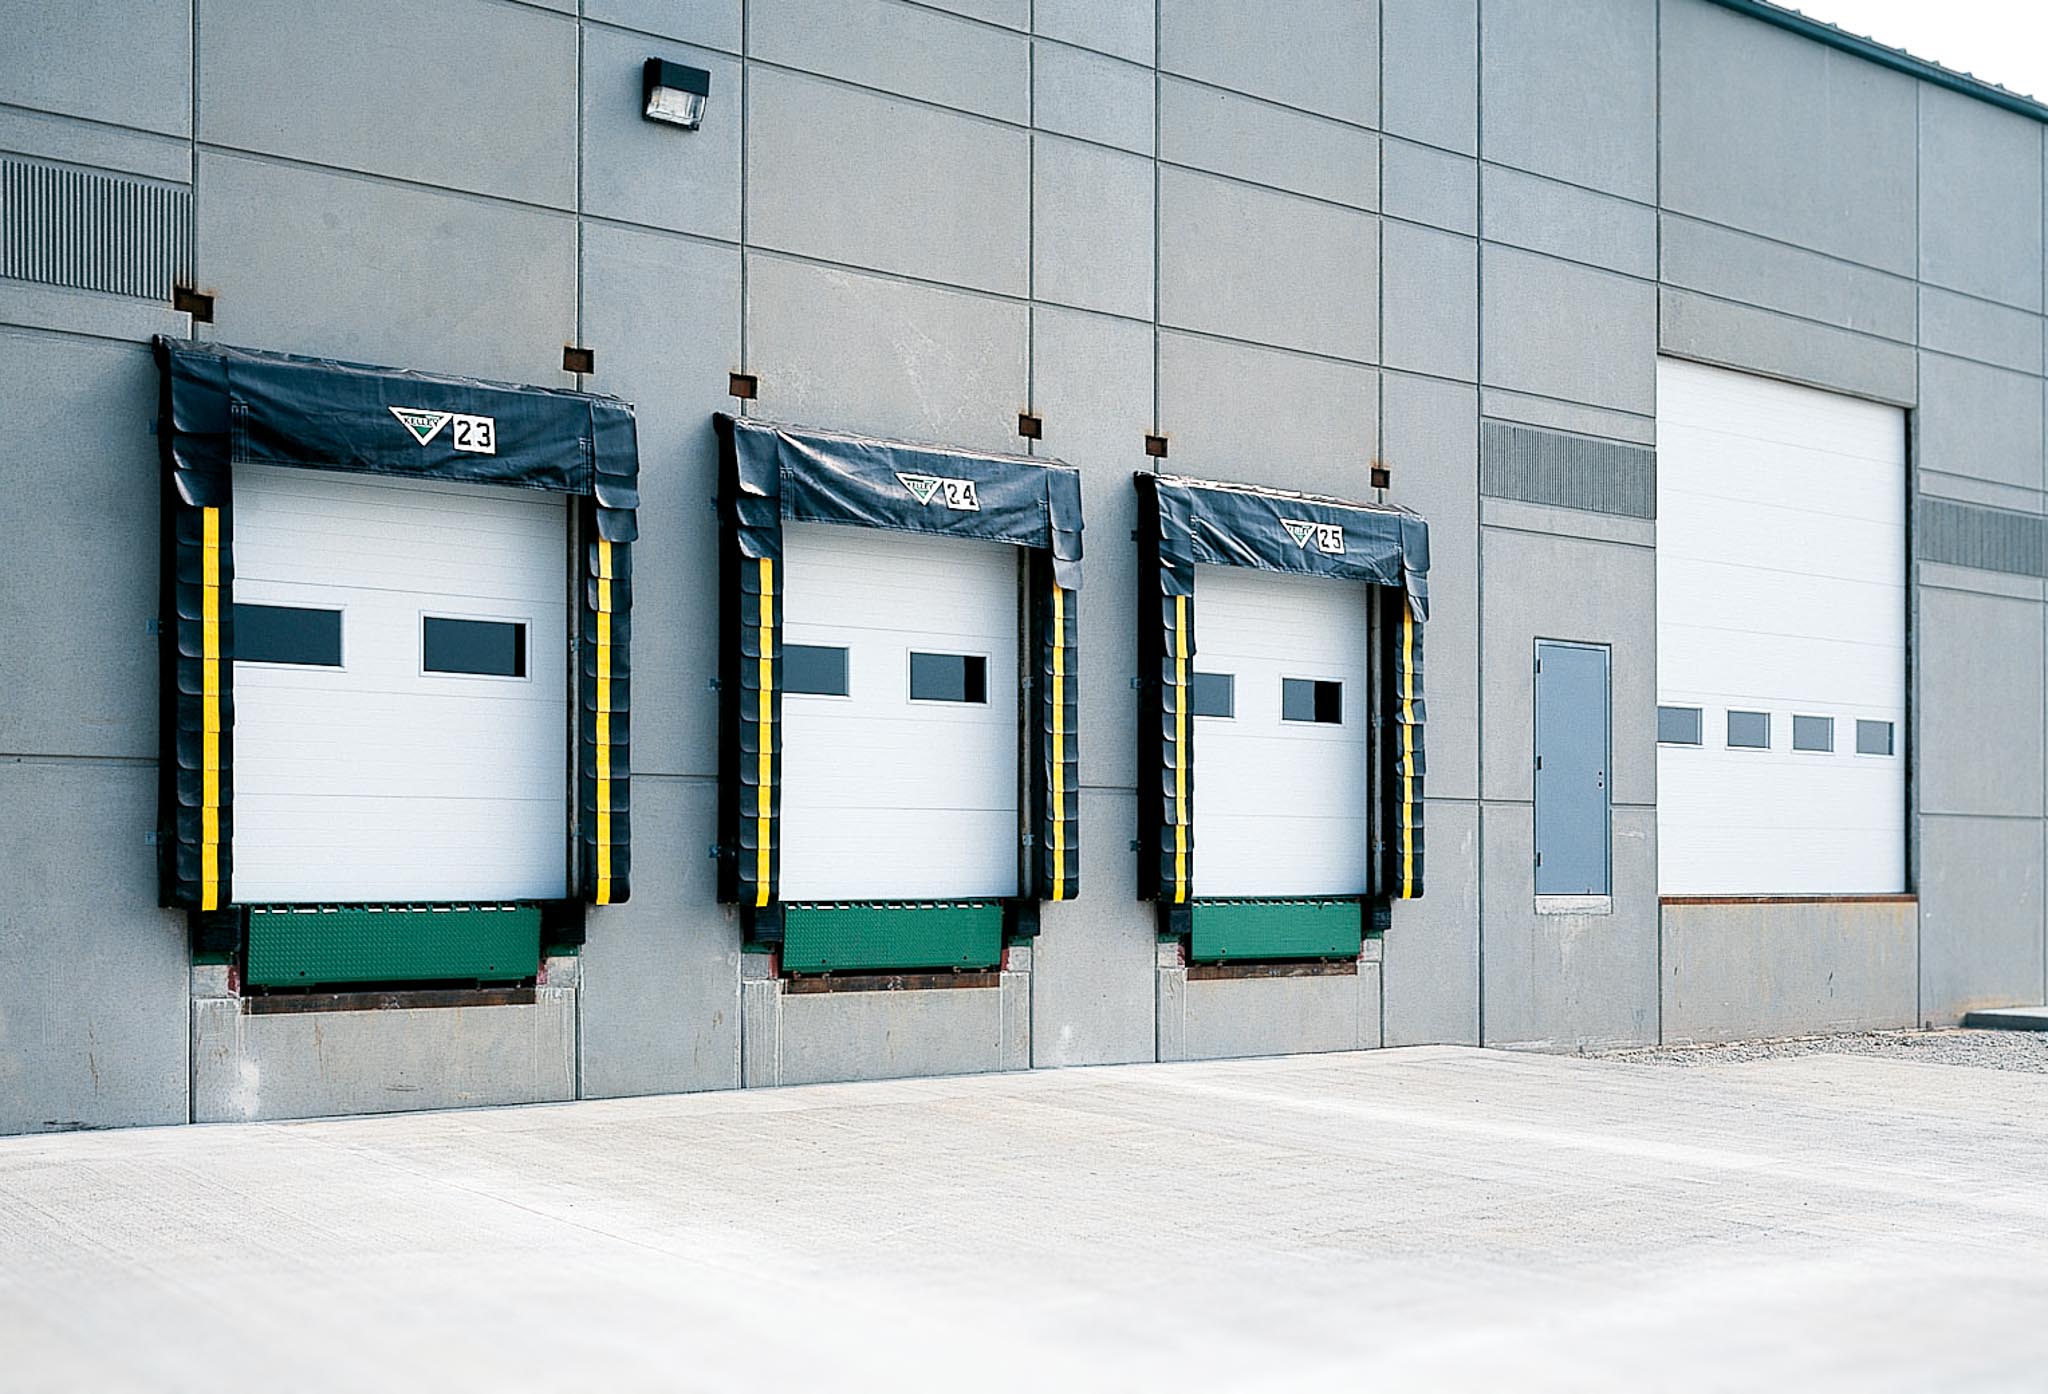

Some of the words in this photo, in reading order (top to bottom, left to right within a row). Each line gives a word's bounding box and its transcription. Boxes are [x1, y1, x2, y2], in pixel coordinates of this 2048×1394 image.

[403, 416, 440, 427] KELLEY
[457, 420, 491, 447] 23
[947, 483, 976, 506] 24
[1319, 529, 1341, 549] 25
